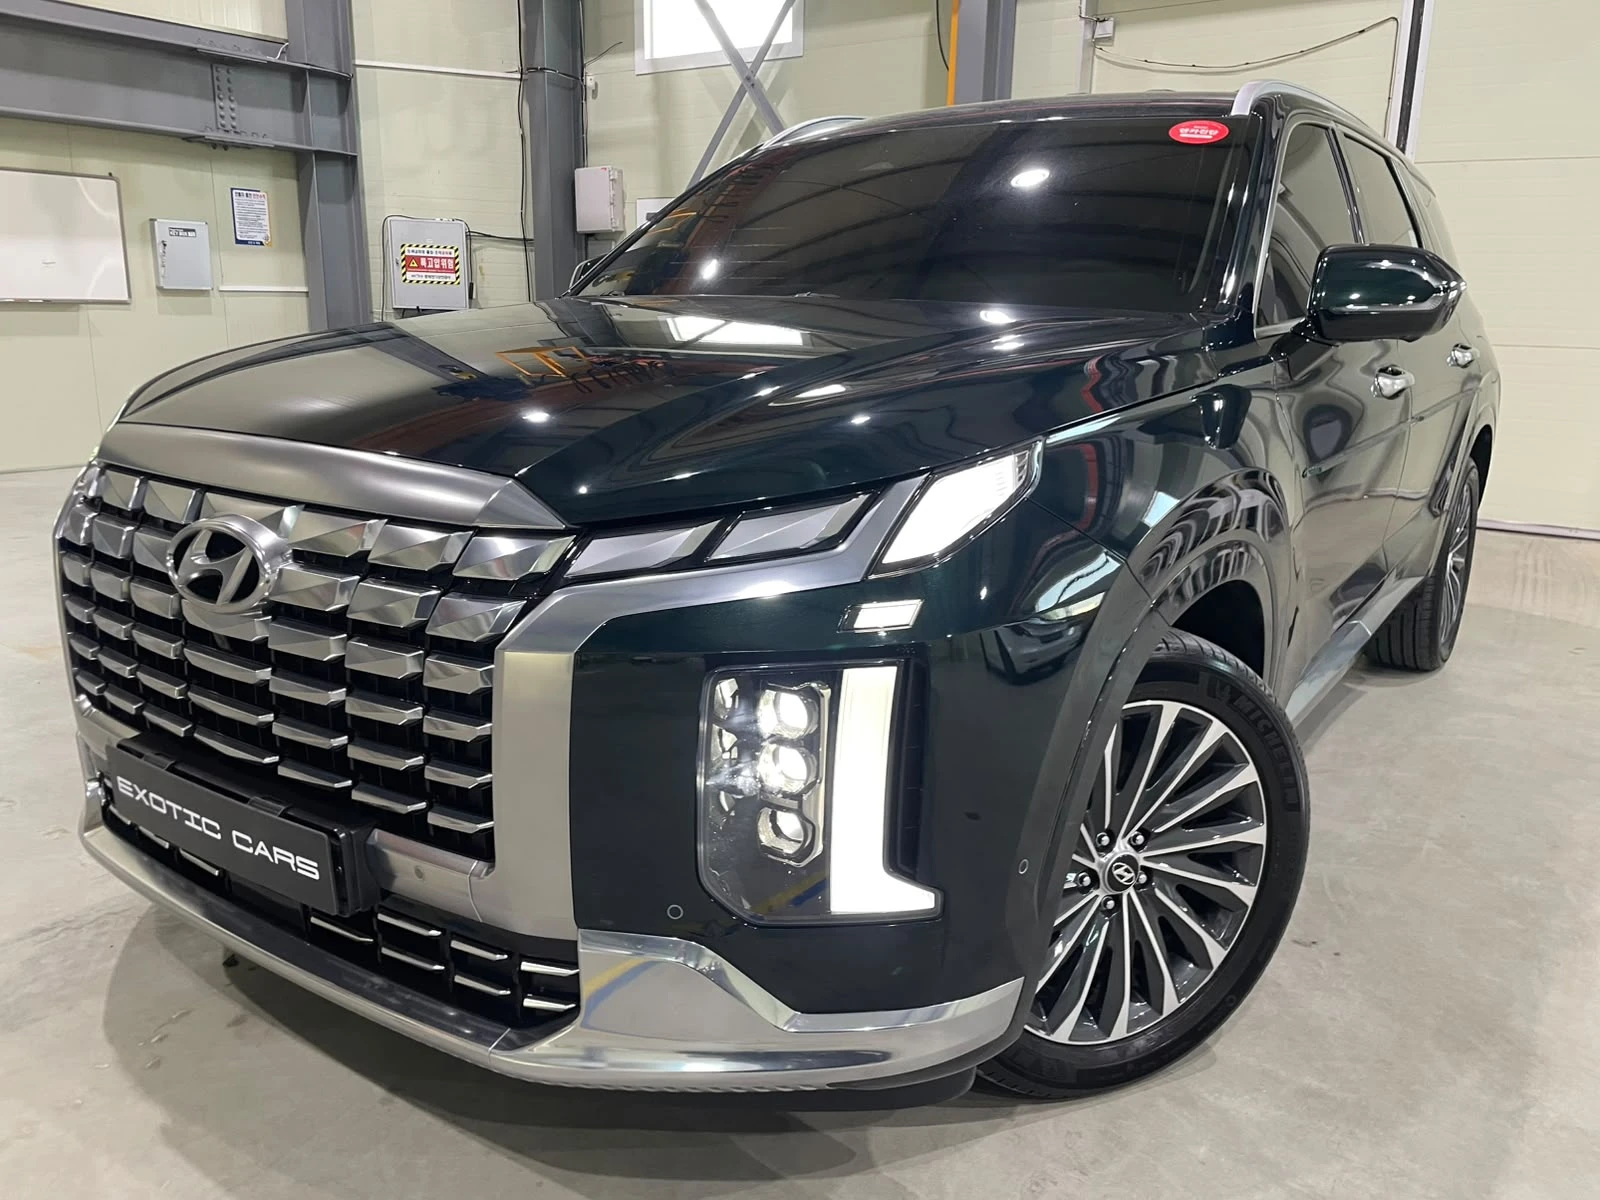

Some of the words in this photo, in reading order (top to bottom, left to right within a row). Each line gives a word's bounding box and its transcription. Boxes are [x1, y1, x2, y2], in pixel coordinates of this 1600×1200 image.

[420, 257, 454, 269] 특고압위험
[1231, 694, 1300, 812] MICHELIN
[116, 775, 222, 840] EXOTIC
[231, 829, 320, 880] CARS
